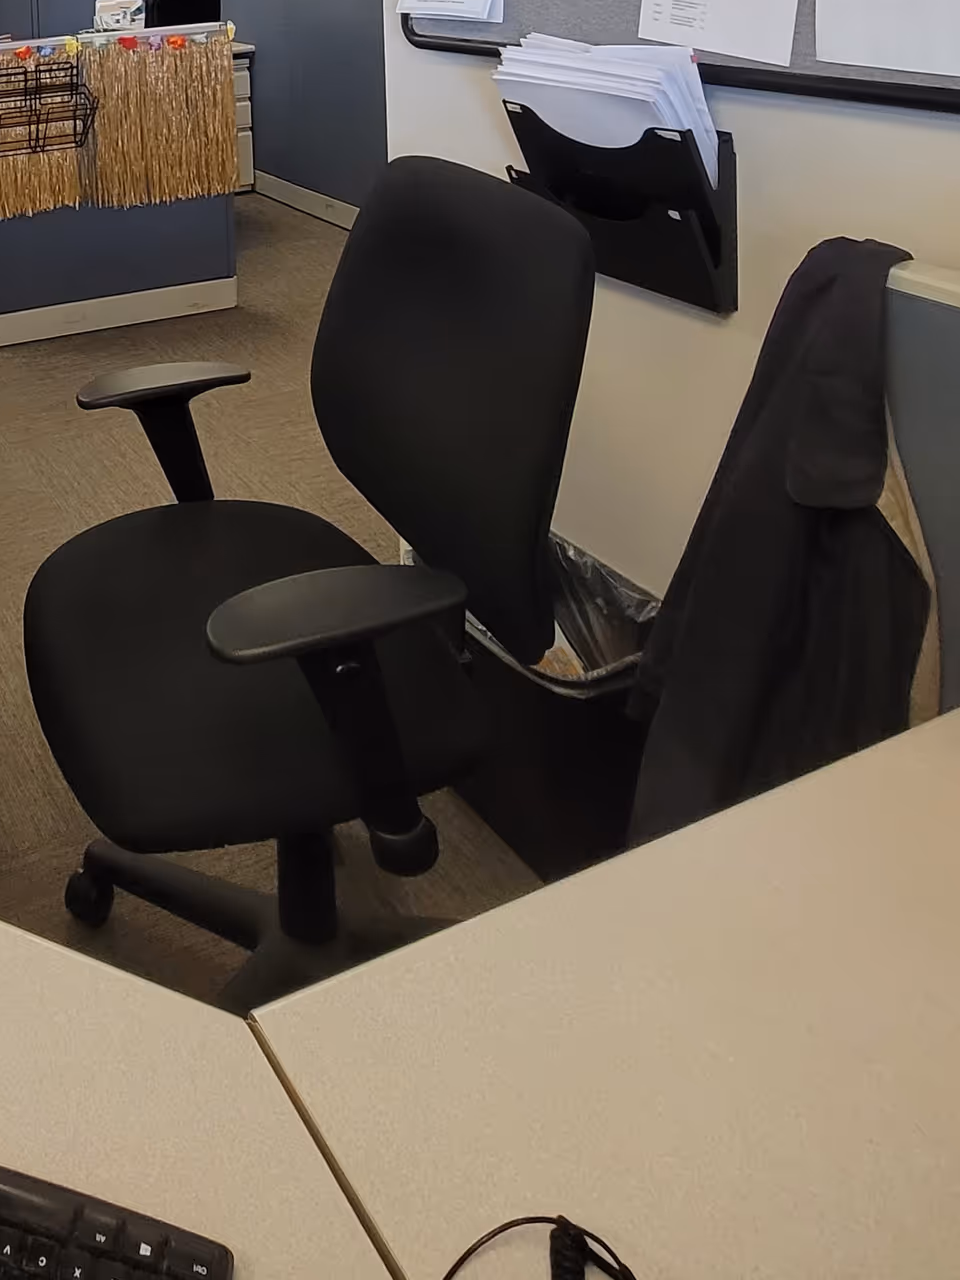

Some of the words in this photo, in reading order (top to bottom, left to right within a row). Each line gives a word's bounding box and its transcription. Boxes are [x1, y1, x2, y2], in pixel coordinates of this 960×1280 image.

[3, 1244, 11, 1255] V
[38, 1256, 47, 1267] C
[73, 1266, 82, 1278] X
